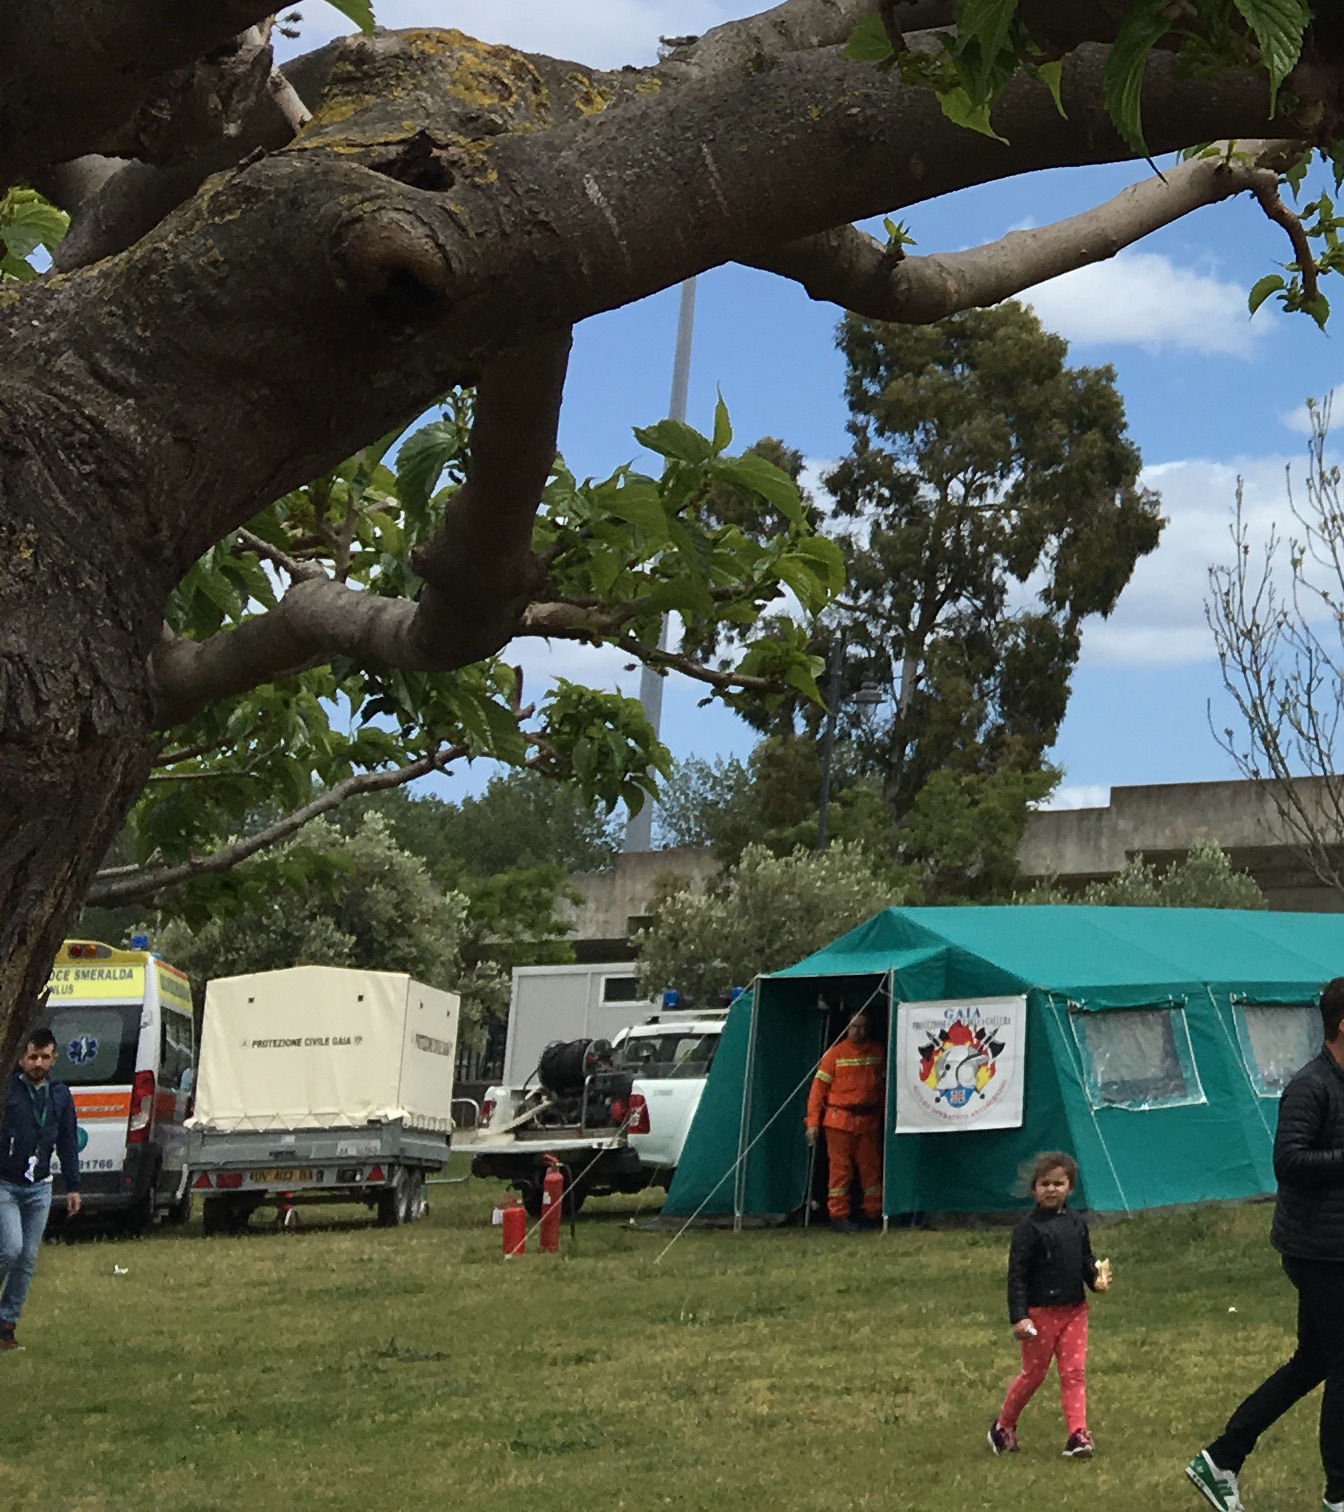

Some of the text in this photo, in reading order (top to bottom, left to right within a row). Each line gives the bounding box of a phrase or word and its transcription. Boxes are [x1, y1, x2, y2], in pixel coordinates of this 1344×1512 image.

[50, 968, 134, 982] OCE SMERALDA
[50, 983, 74, 995] NLUS
[944, 1006, 981, 1019] GAIA
[252, 1036, 351, 1048] PROTEZIONE CIVILE GAIA
